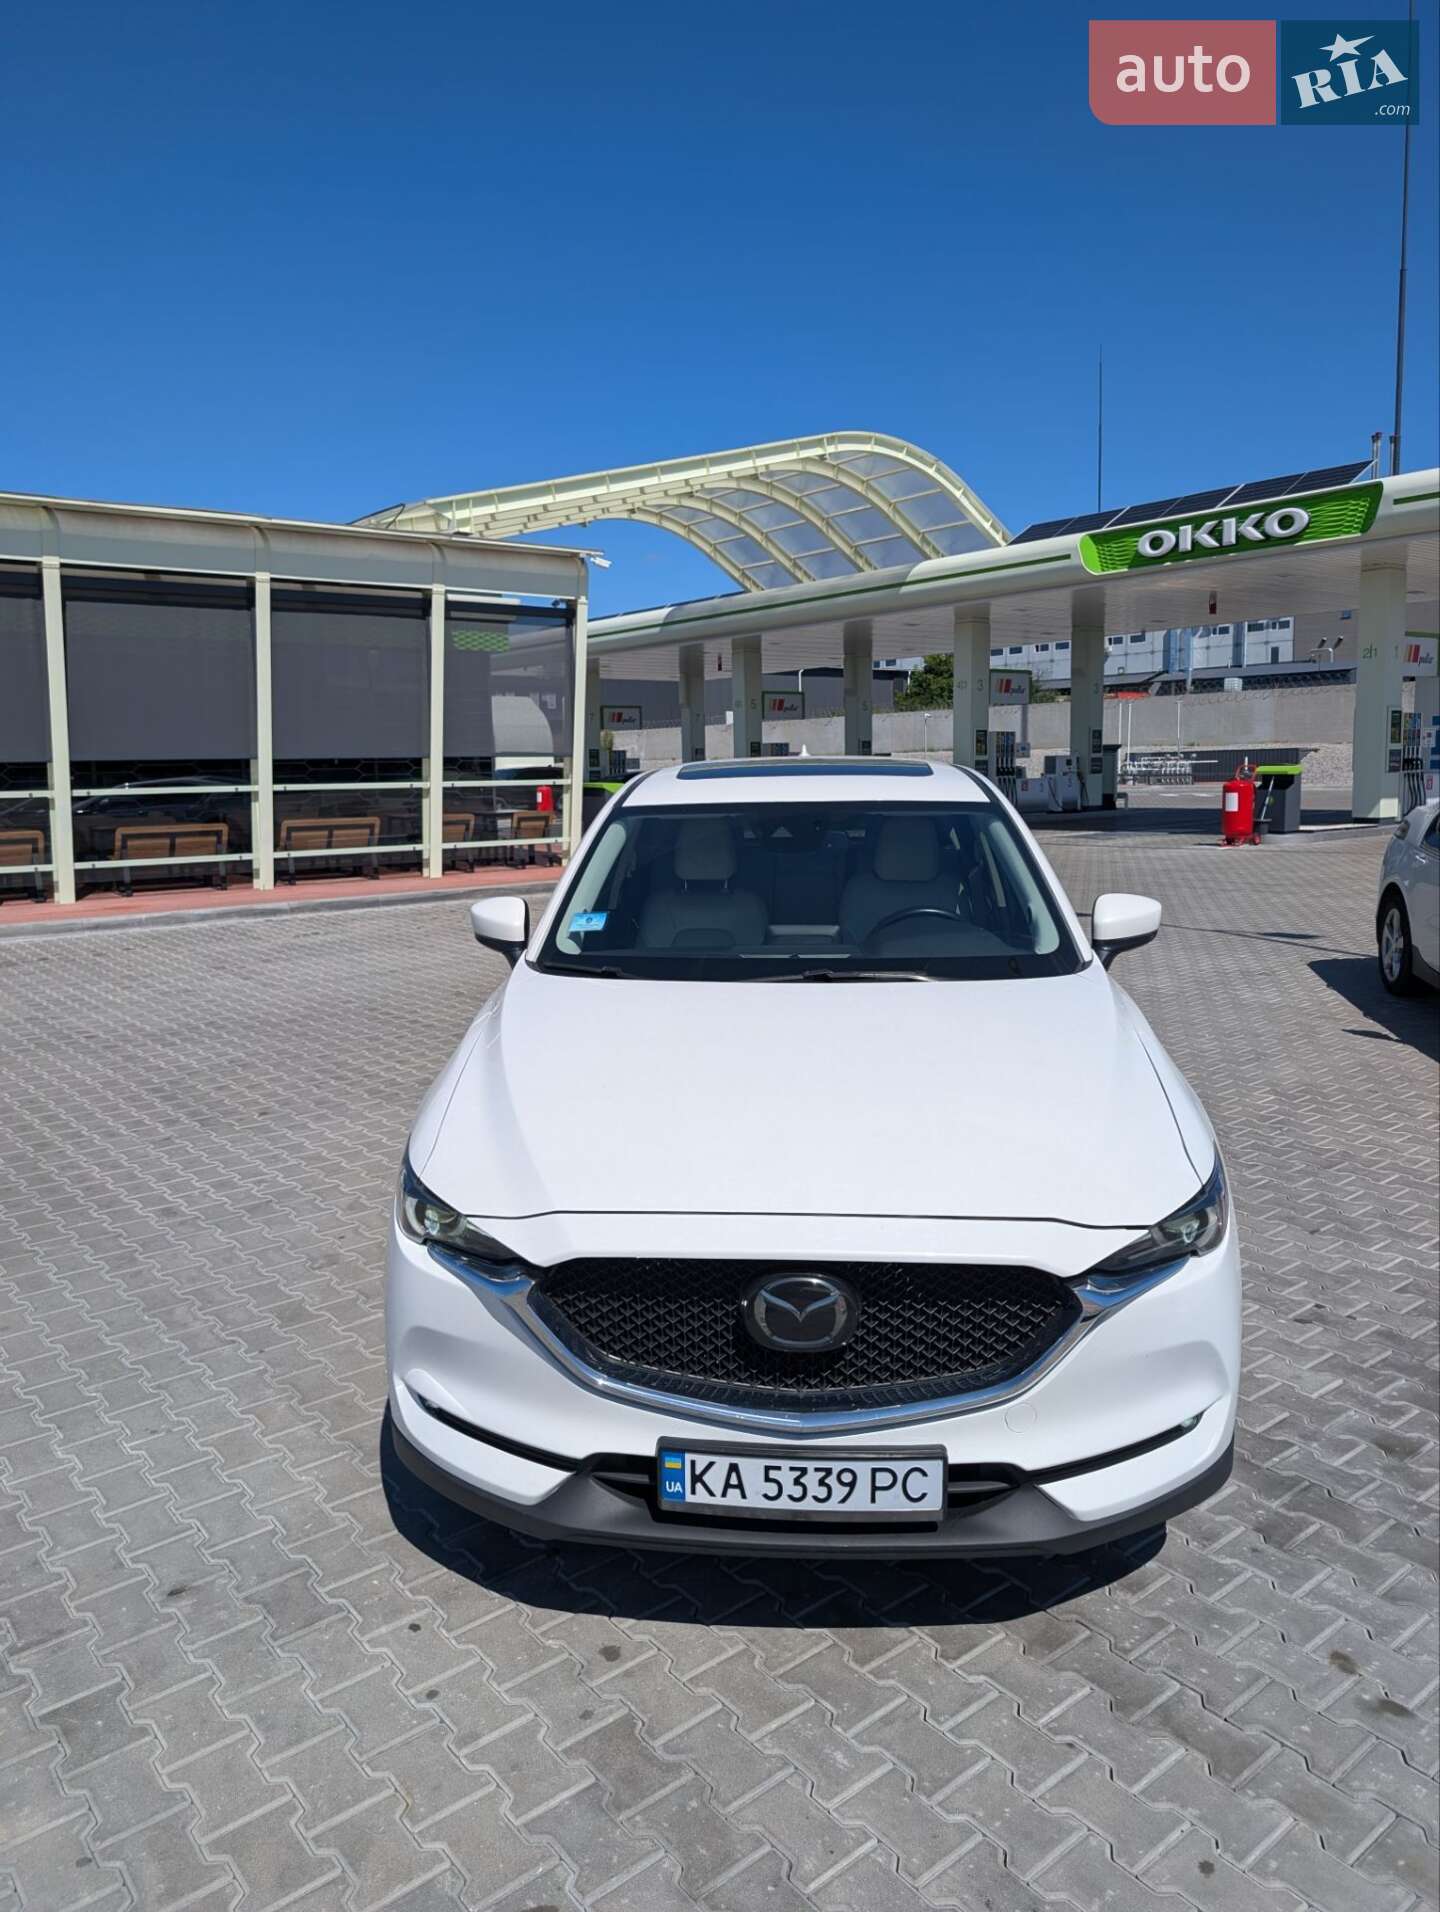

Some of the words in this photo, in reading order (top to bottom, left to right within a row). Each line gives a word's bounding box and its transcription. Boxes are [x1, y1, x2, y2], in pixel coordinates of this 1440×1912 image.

[1137, 507, 1310, 558] OKKO
[666, 1481, 682, 1493] UA
[690, 1460, 747, 1499] KA
[761, 1465, 858, 1504] 5339
[870, 1467, 929, 1504] PC
